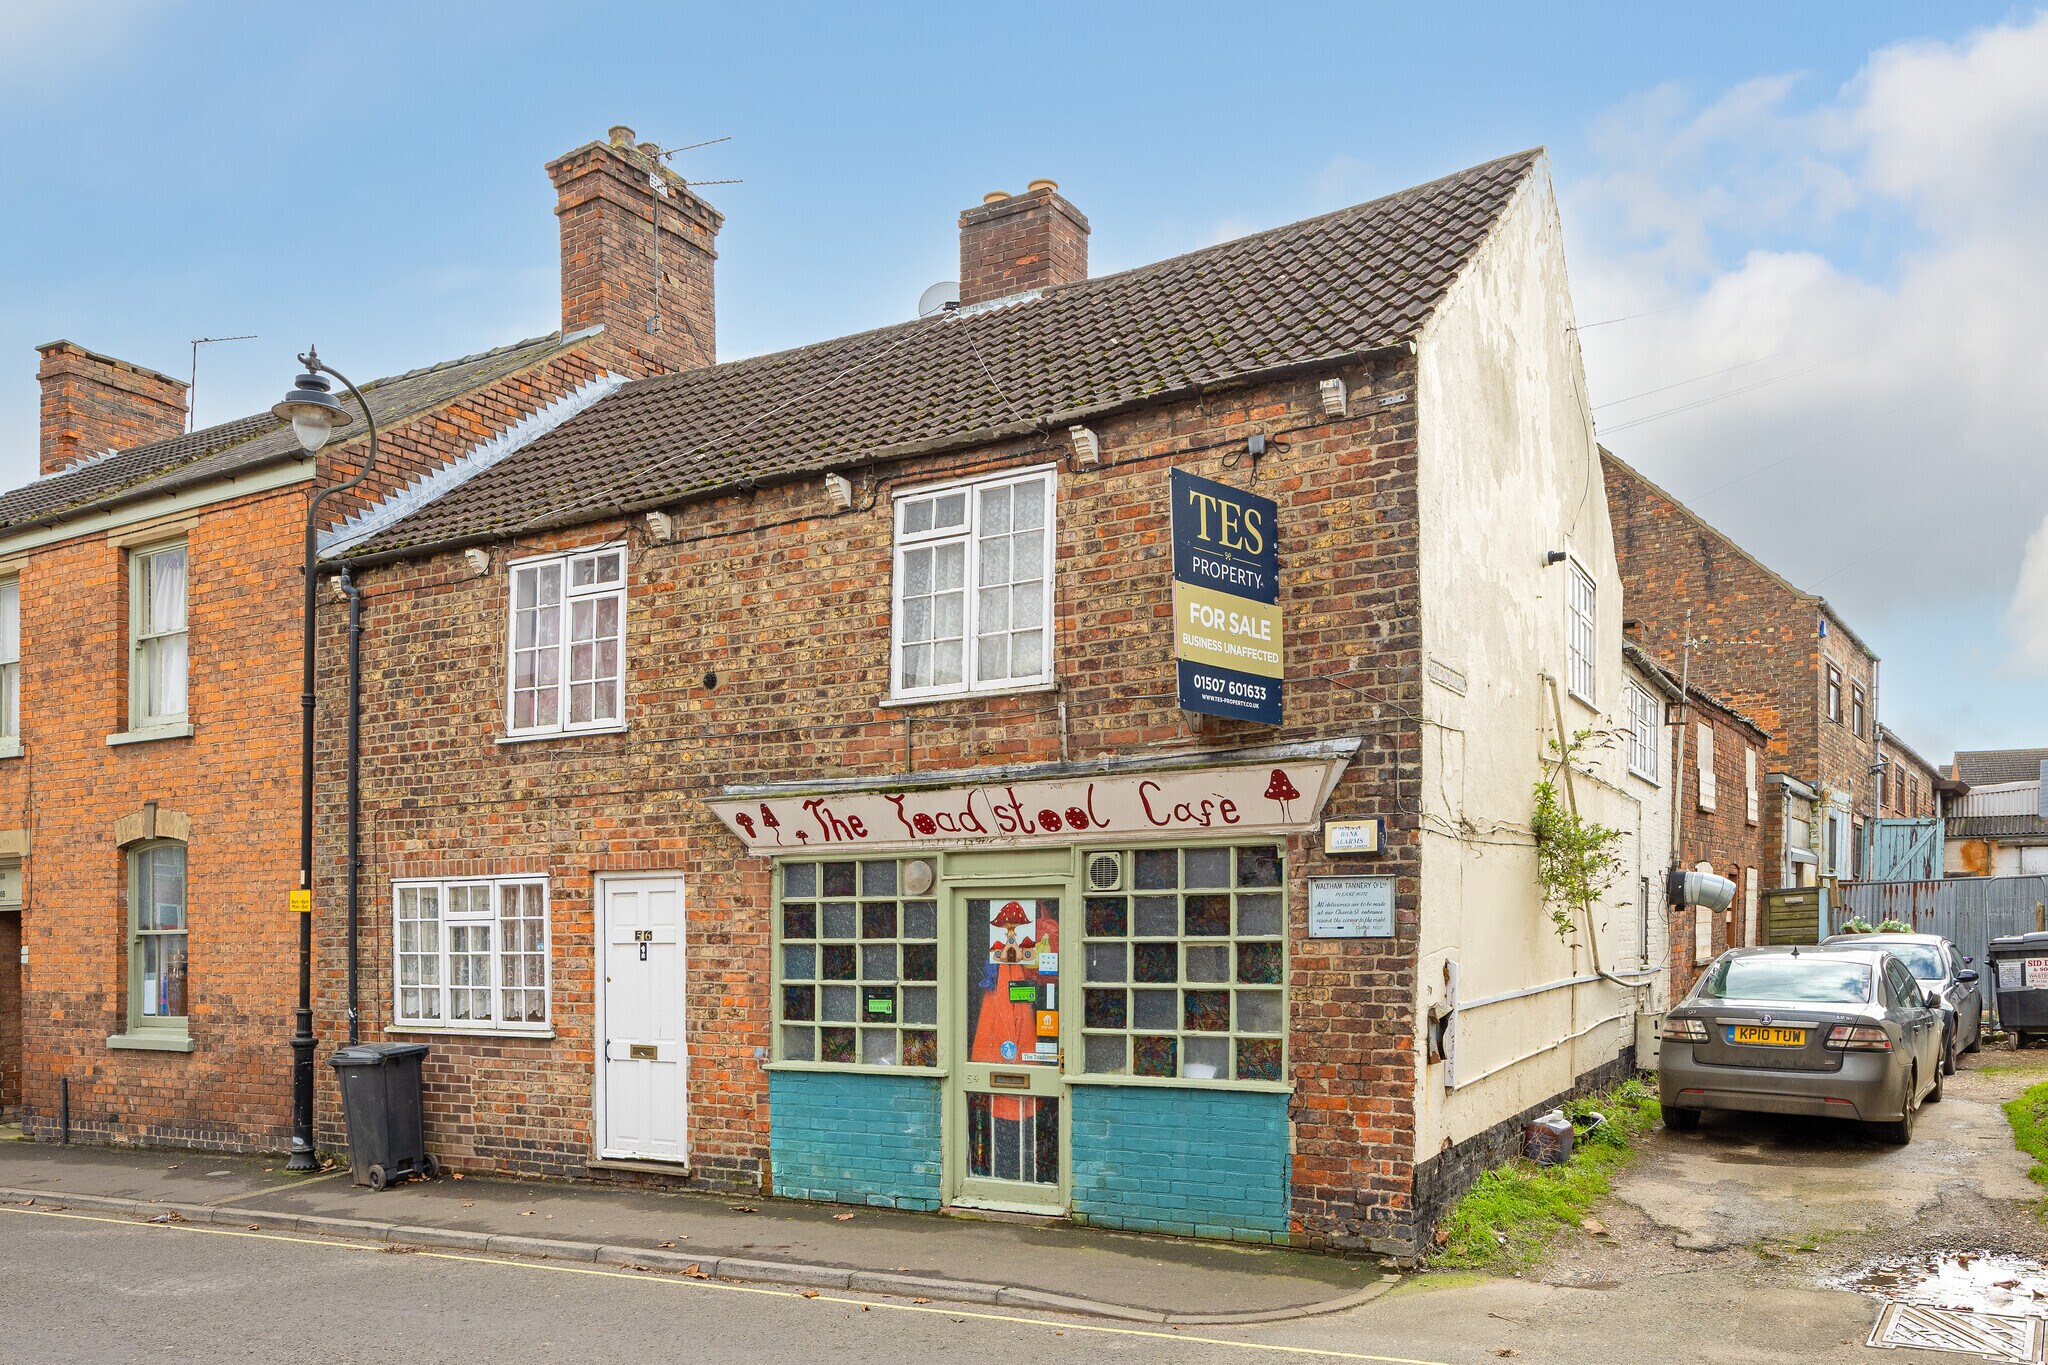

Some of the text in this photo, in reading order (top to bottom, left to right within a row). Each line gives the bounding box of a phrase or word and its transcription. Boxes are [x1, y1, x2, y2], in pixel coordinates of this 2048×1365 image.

[1189, 490, 1263, 555] TES
[1192, 556, 1262, 589] PROPERTY
[1190, 602, 1271, 641] FOR SALE
[1183, 633, 1279, 663] BUSINESS UNAFFECTED
[1194, 674, 1267, 700] 01507 601633
[1202, 693, 1260, 709] WWW.TES-PROPERTY.CO.UK
[803, 798, 868, 842] The
[637, 930, 652, 940] 56
[1774, 1029, 1801, 1043] TUW
